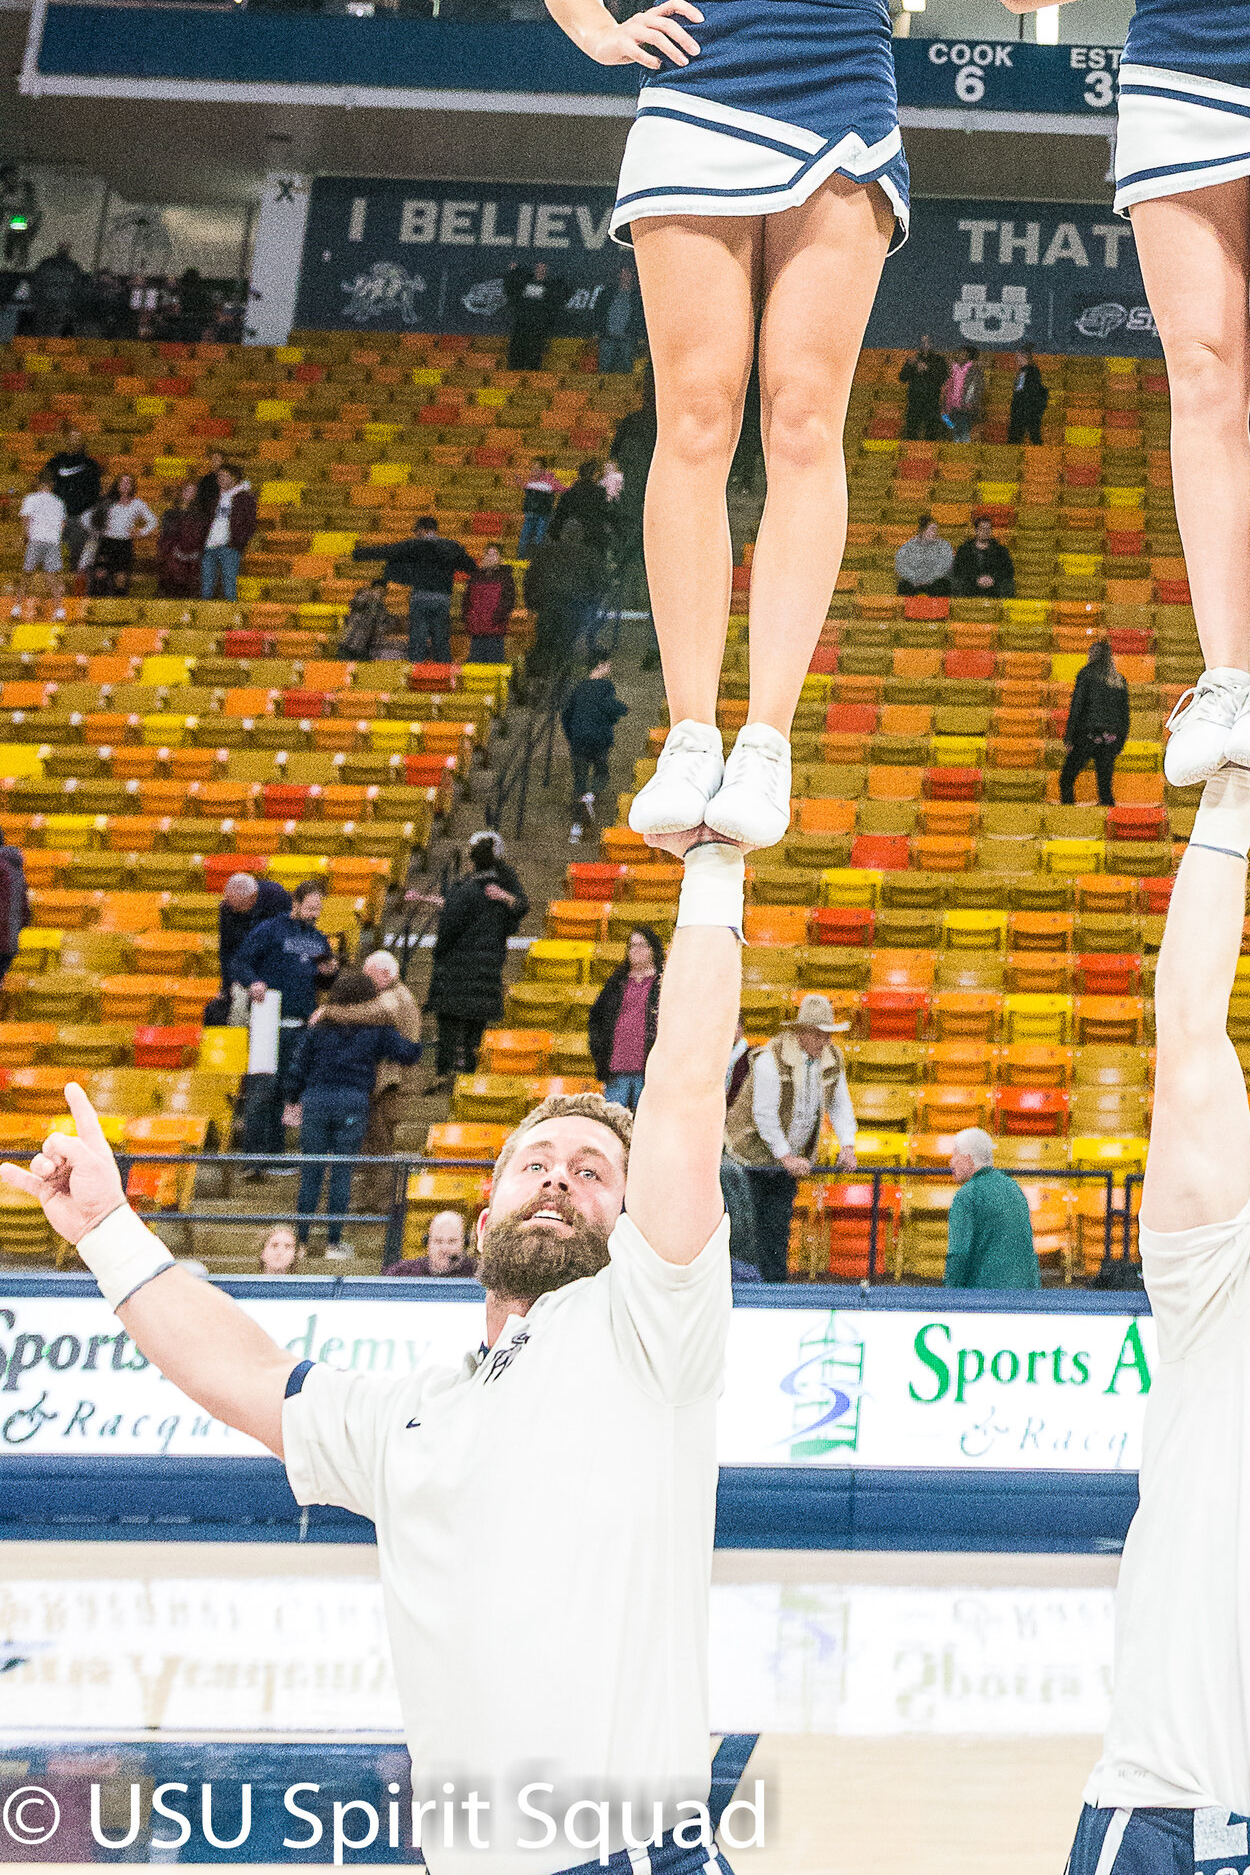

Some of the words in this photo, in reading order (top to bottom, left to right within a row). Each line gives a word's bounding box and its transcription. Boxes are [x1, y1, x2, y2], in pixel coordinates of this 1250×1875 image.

[928, 42, 1014, 67] COOK
[954, 65, 986, 103] 6
[1083, 70, 1119, 108] 3
[349, 197, 367, 242] I
[957, 220, 1133, 269] THAT
[908, 1322, 1091, 1404] Sports
